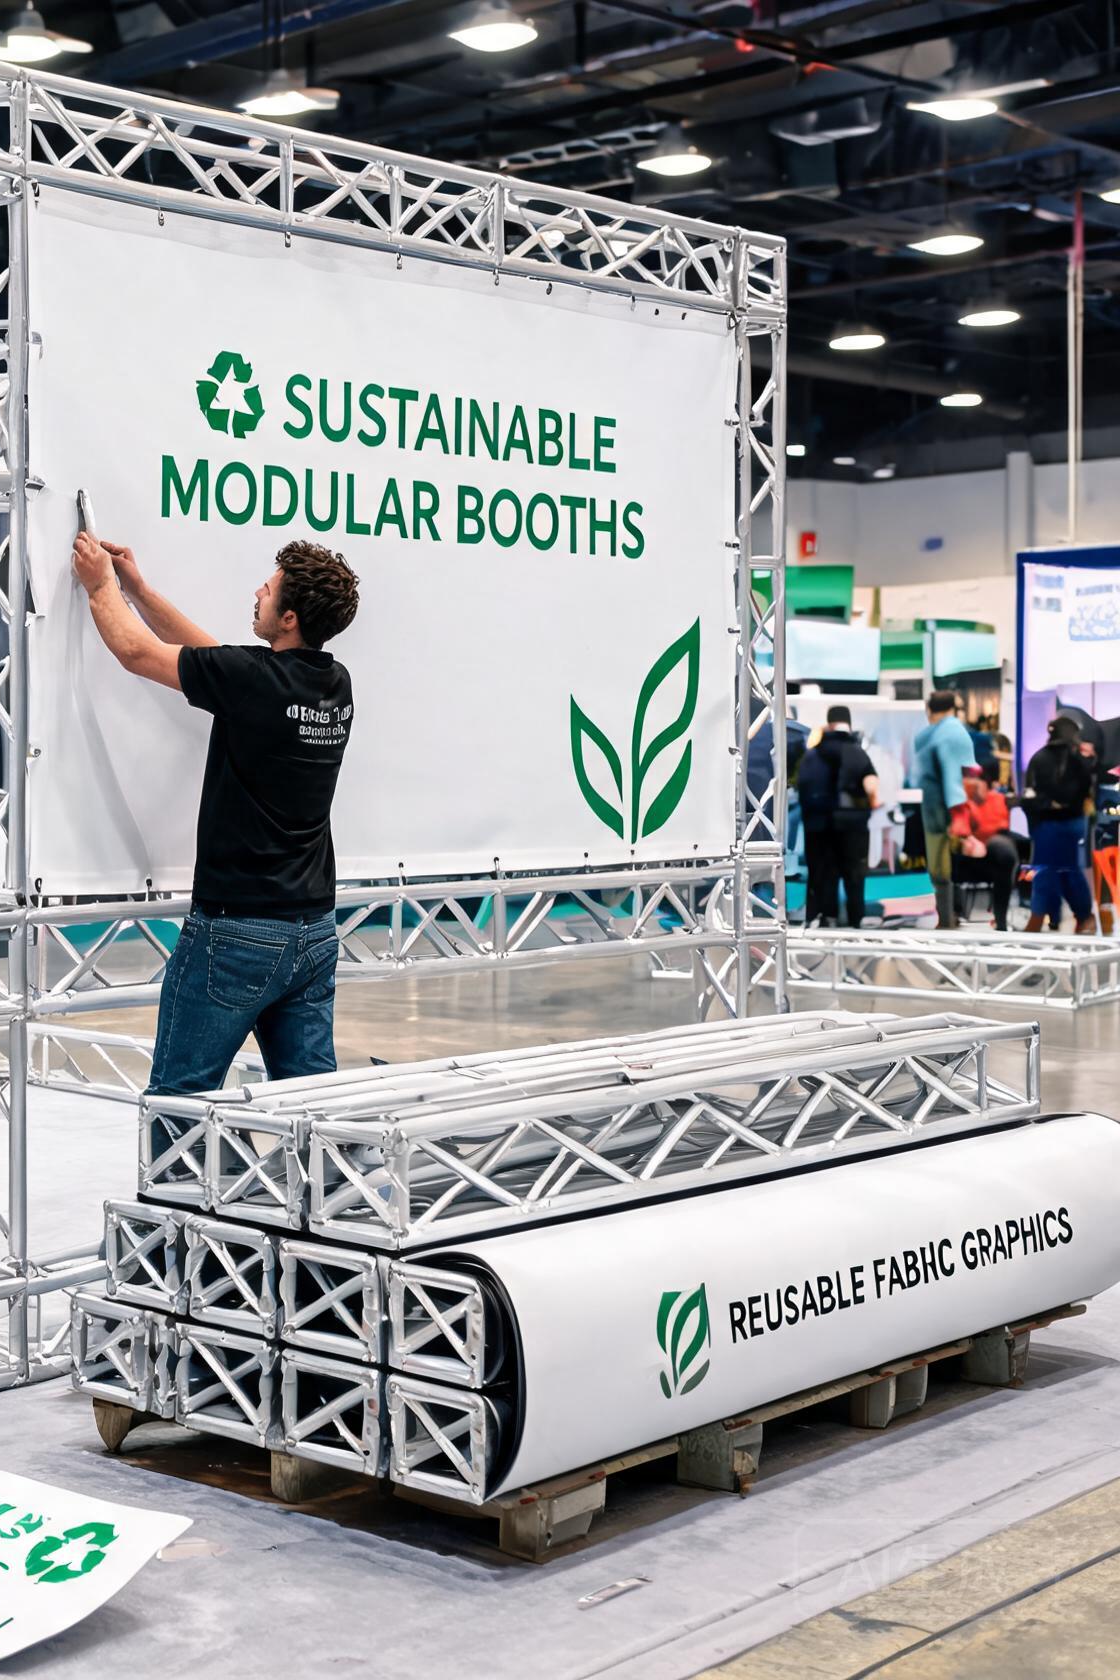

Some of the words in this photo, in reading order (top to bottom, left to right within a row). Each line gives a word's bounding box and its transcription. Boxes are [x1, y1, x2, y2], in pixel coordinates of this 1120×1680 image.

[282, 373, 617, 474] SUSTAINABLE
[161, 454, 442, 542] MODULAR
[457, 484, 645, 560] BOOTHS
[728, 1265, 865, 1344] REUSABLE
[960, 1206, 1073, 1271] GRAPHICS
